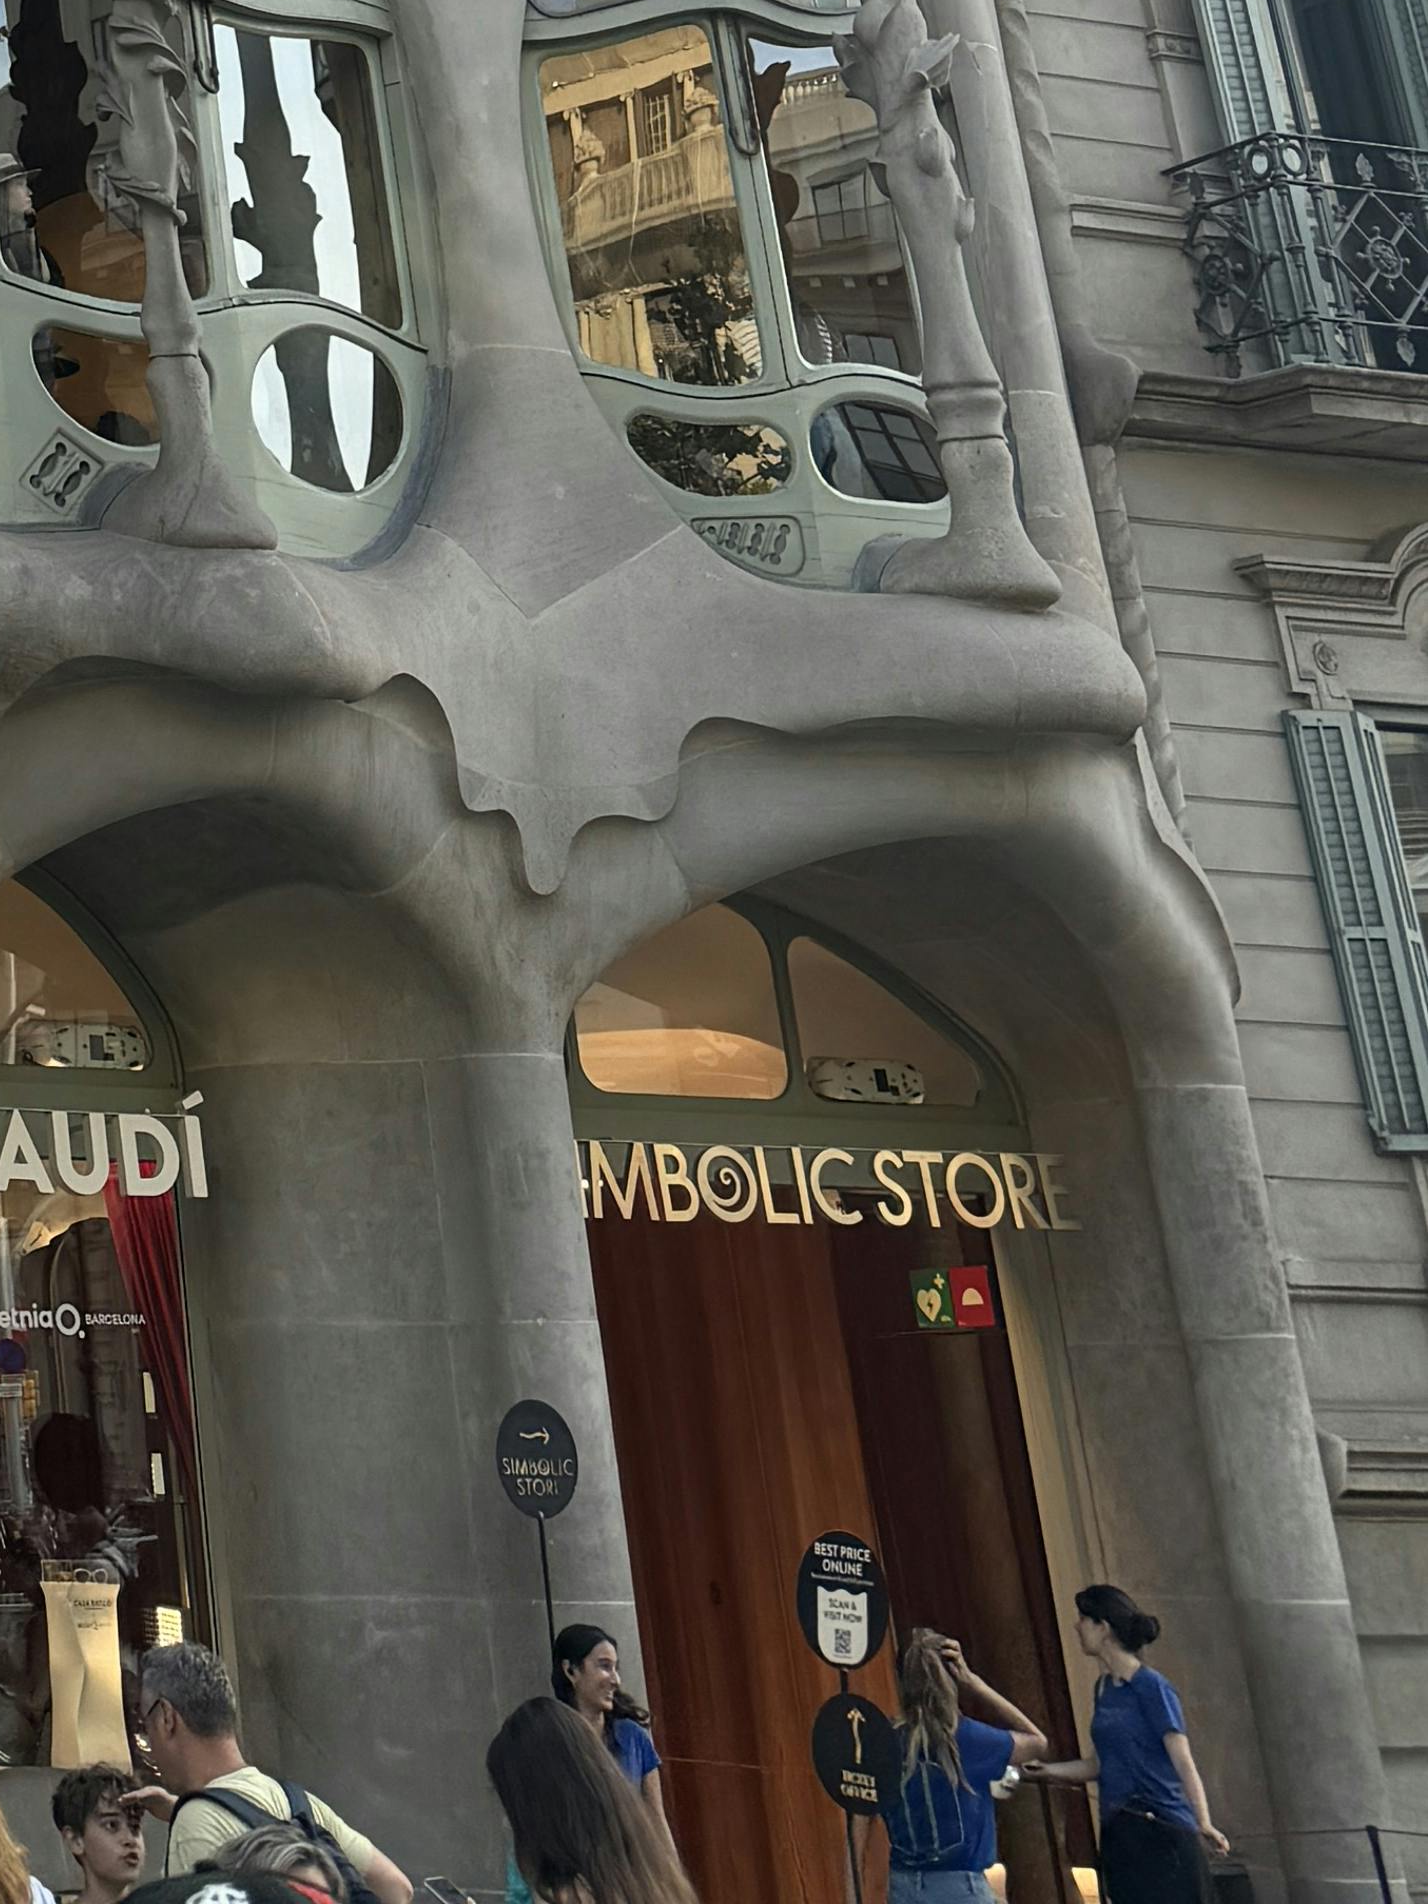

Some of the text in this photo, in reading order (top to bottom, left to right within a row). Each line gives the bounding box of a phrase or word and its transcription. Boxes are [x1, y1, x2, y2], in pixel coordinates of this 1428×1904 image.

[873, 1148, 1082, 1230] STORE
[85, 1313, 146, 1325] BARCELONA
[814, 1542, 871, 1563] BEST PRICE
[822, 1559, 863, 1576] ONLINE
